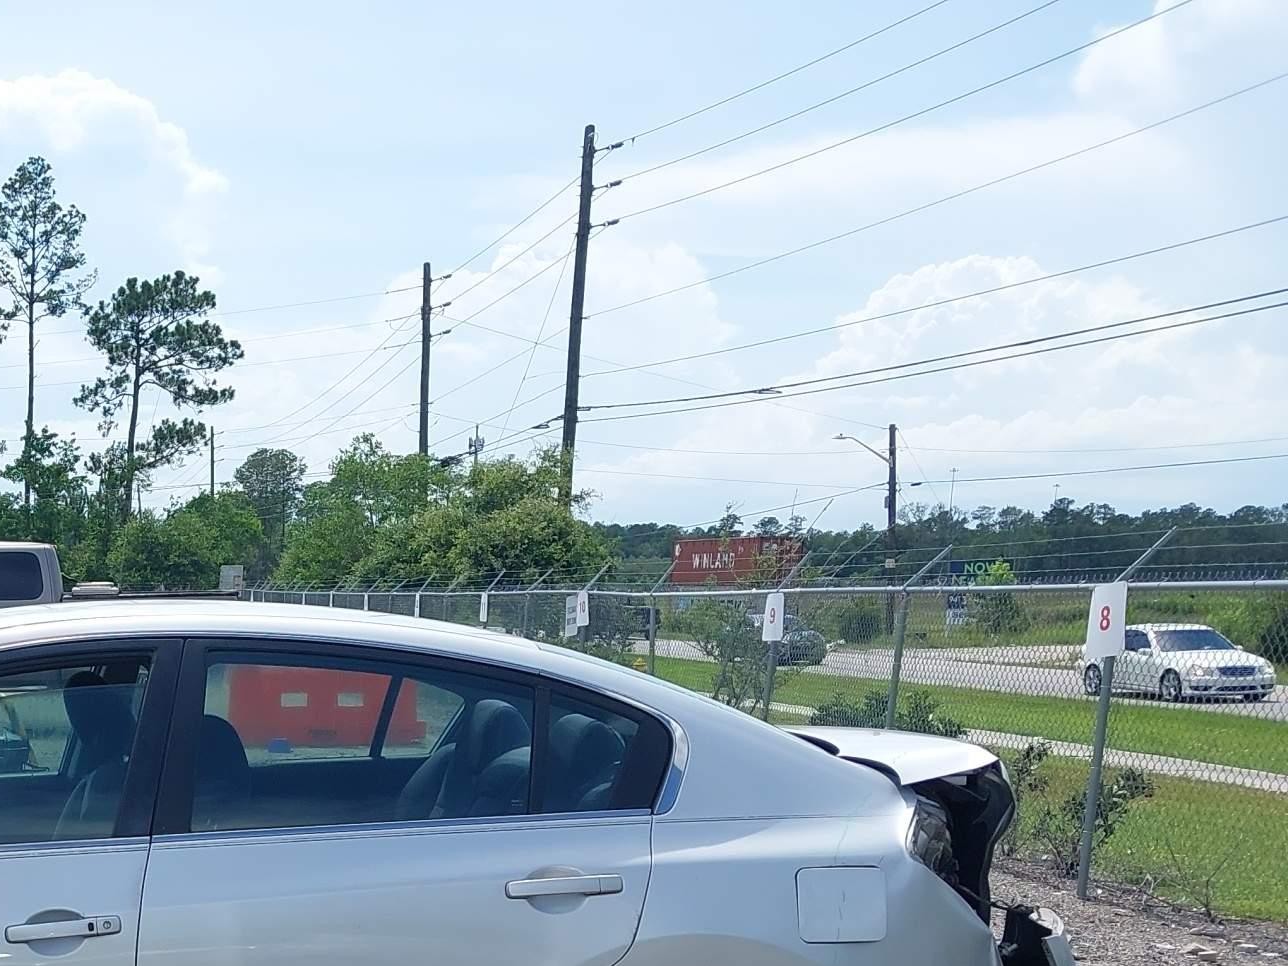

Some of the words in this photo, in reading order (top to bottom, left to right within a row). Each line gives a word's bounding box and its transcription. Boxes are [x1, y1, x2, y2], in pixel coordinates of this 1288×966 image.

[579, 601, 586, 614] 10
[769, 607, 776, 624] 9
[1100, 606, 1110, 631] 8
